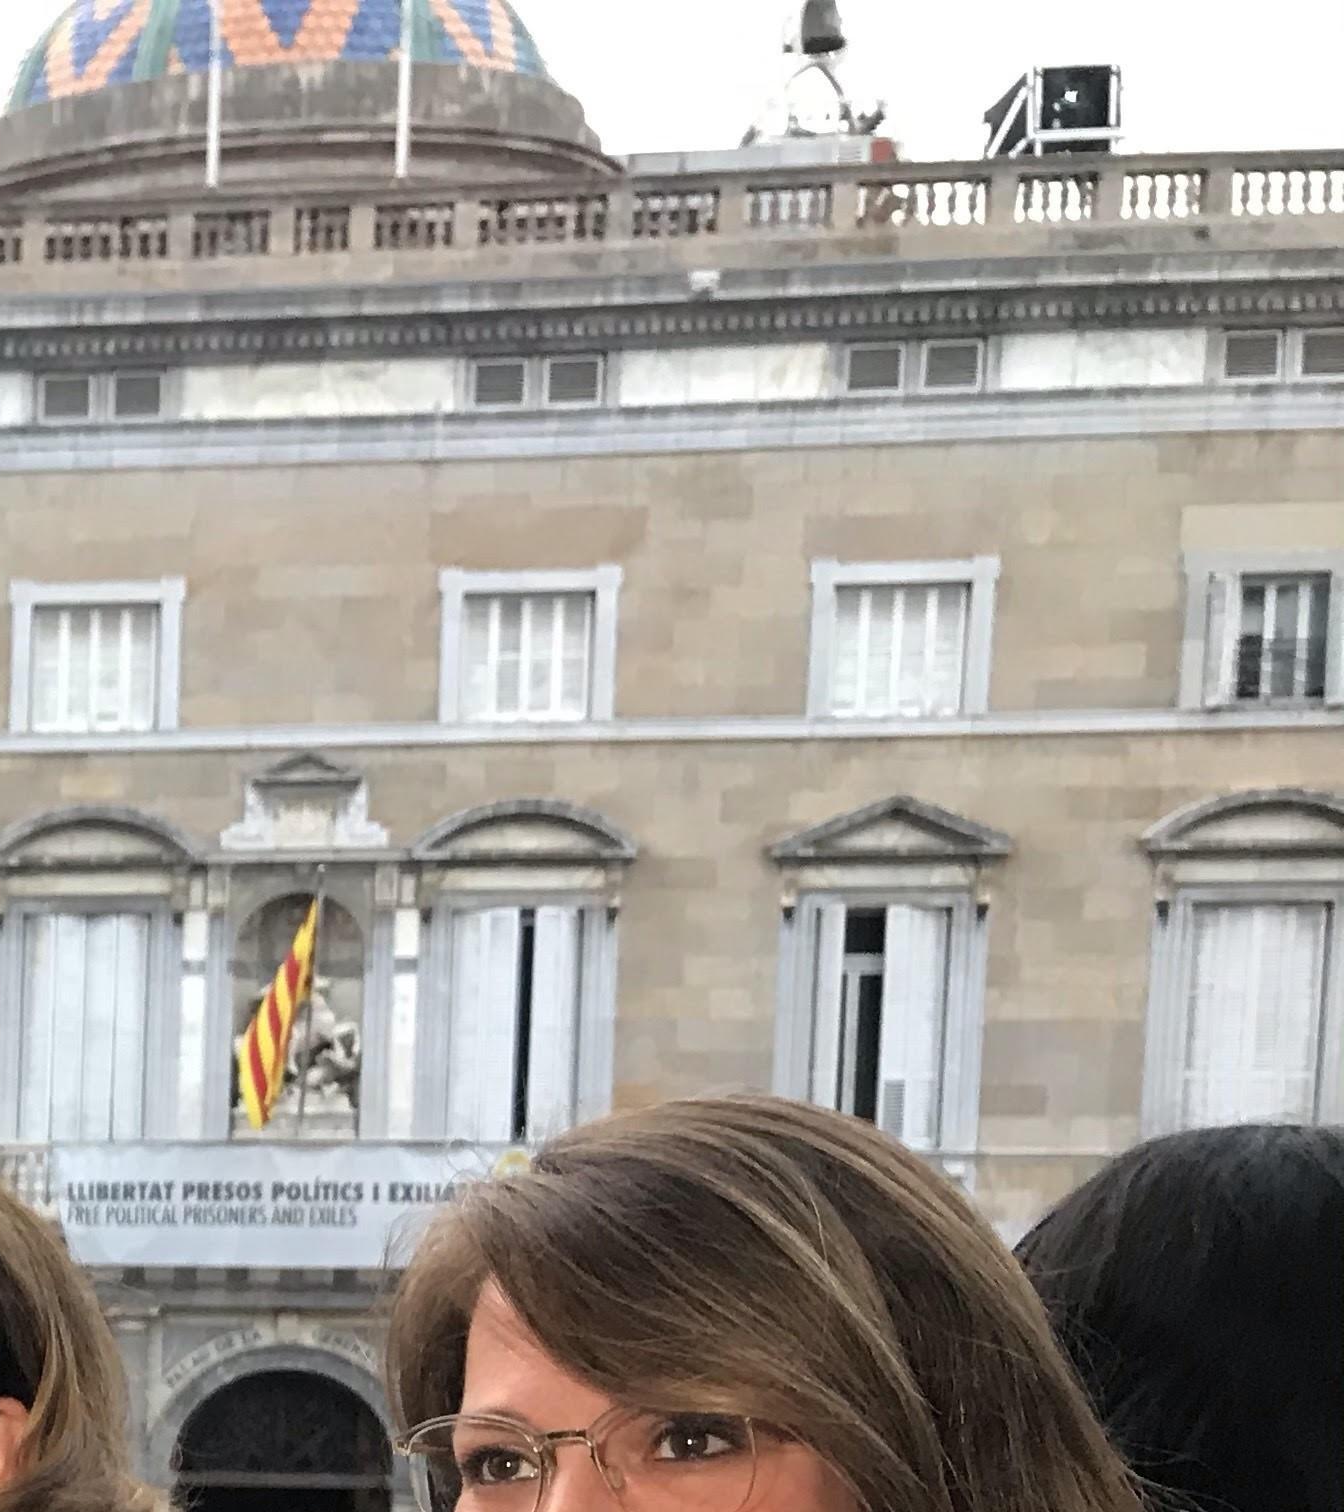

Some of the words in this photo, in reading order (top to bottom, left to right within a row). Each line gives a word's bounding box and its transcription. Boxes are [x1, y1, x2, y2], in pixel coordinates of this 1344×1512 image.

[67, 1180, 175, 1202] LLIBERTAT
[181, 1180, 264, 1202] PRESOS
[270, 1175, 365, 1202] POLÍTICS
[372, 1181, 381, 1203] I
[67, 1205, 100, 1226] FREE
[105, 1205, 179, 1226] POLITICAL
[182, 1205, 267, 1227] PRISONERS
[270, 1205, 305, 1226] AND
[308, 1205, 358, 1227] EXILES
